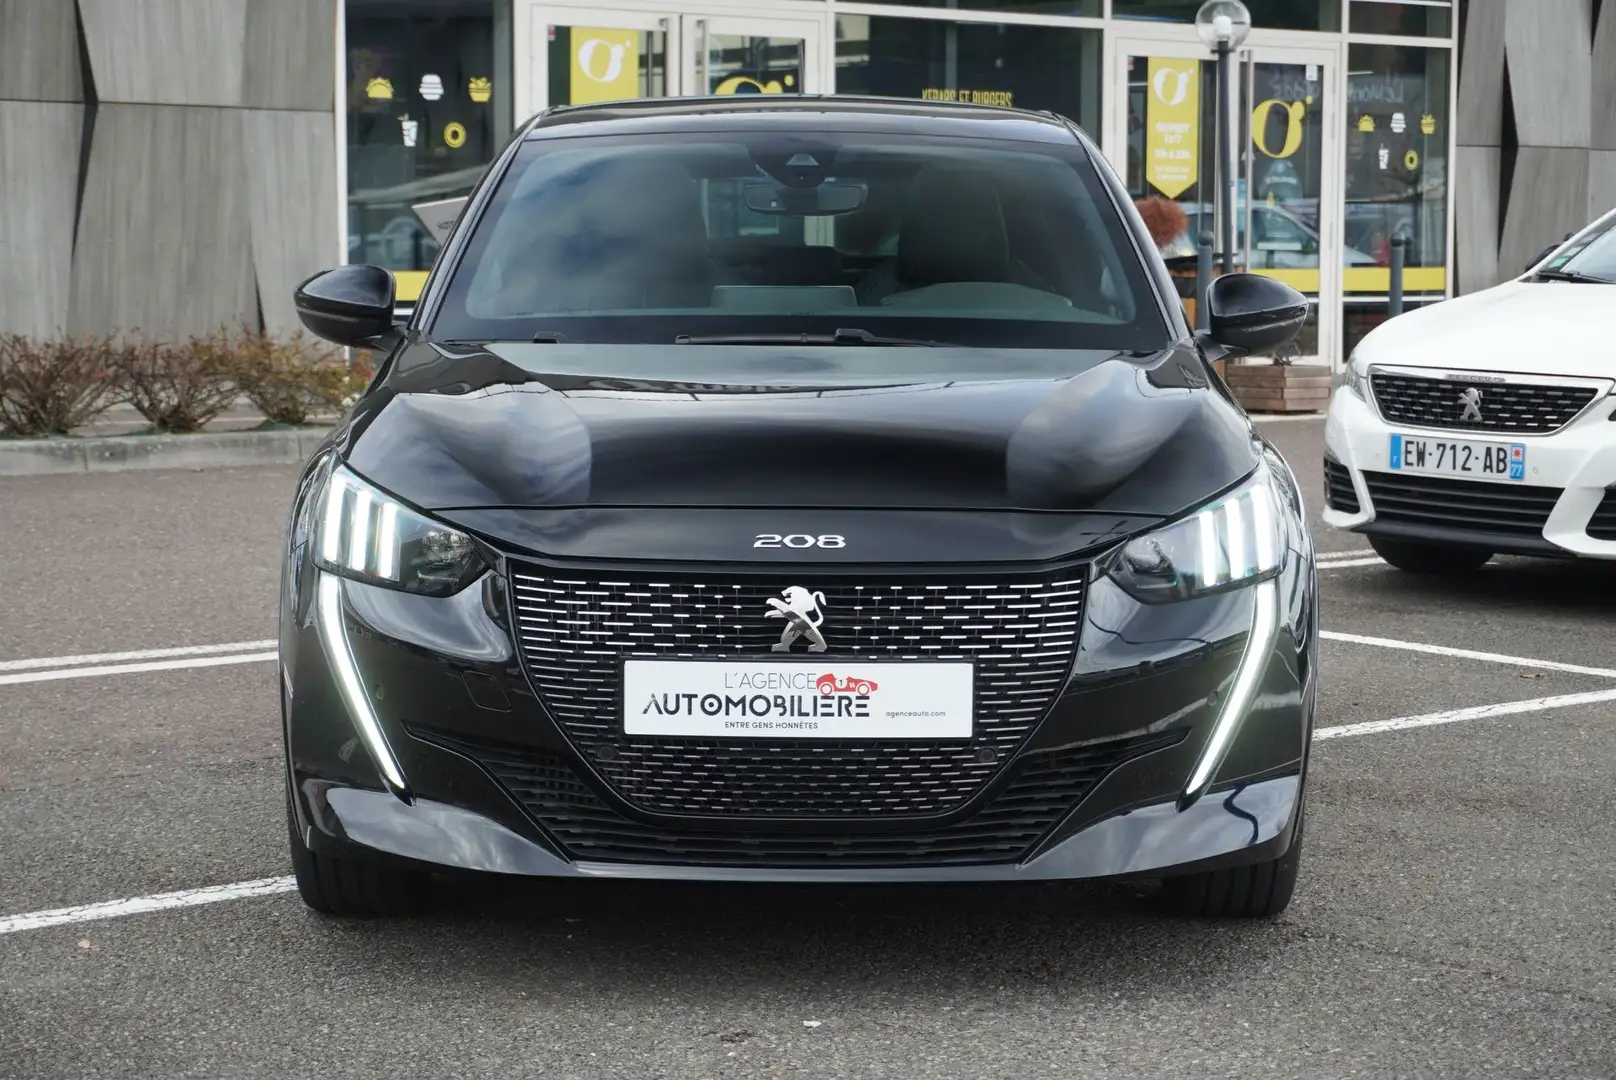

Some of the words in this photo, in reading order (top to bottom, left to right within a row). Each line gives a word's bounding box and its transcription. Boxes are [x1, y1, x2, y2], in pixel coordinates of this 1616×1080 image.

[1511, 463, 1523, 477] 77
[753, 534, 846, 548] 208
[725, 673, 816, 690] L'AGENCE
[885, 709, 947, 717] agenceauto.com
[725, 721, 749, 729] ENTRE
[752, 721, 773, 729] GENS
